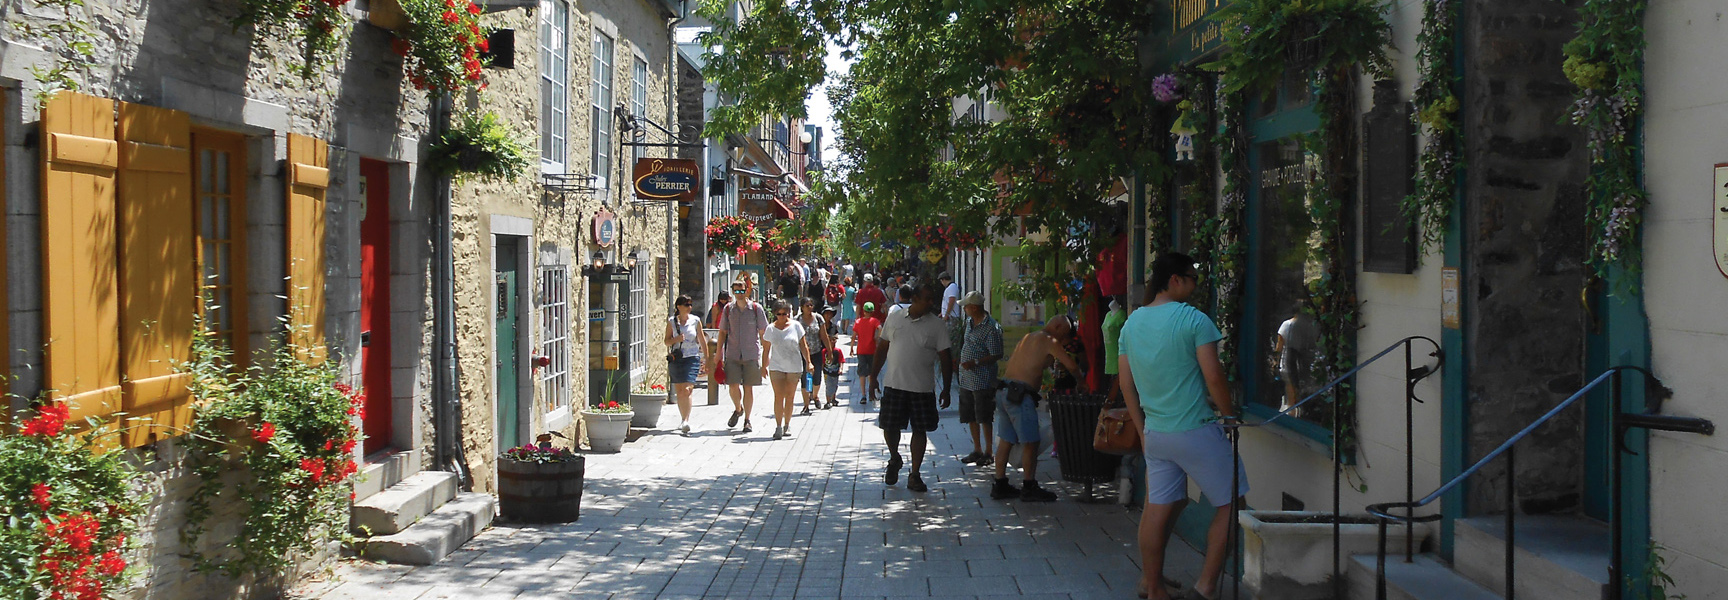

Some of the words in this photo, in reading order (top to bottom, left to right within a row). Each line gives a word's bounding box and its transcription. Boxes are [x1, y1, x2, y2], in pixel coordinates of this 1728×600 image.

[655, 182, 691, 193] PERRIER
[740, 211, 773, 225] Sculpteur
[589, 311, 604, 319] vert
